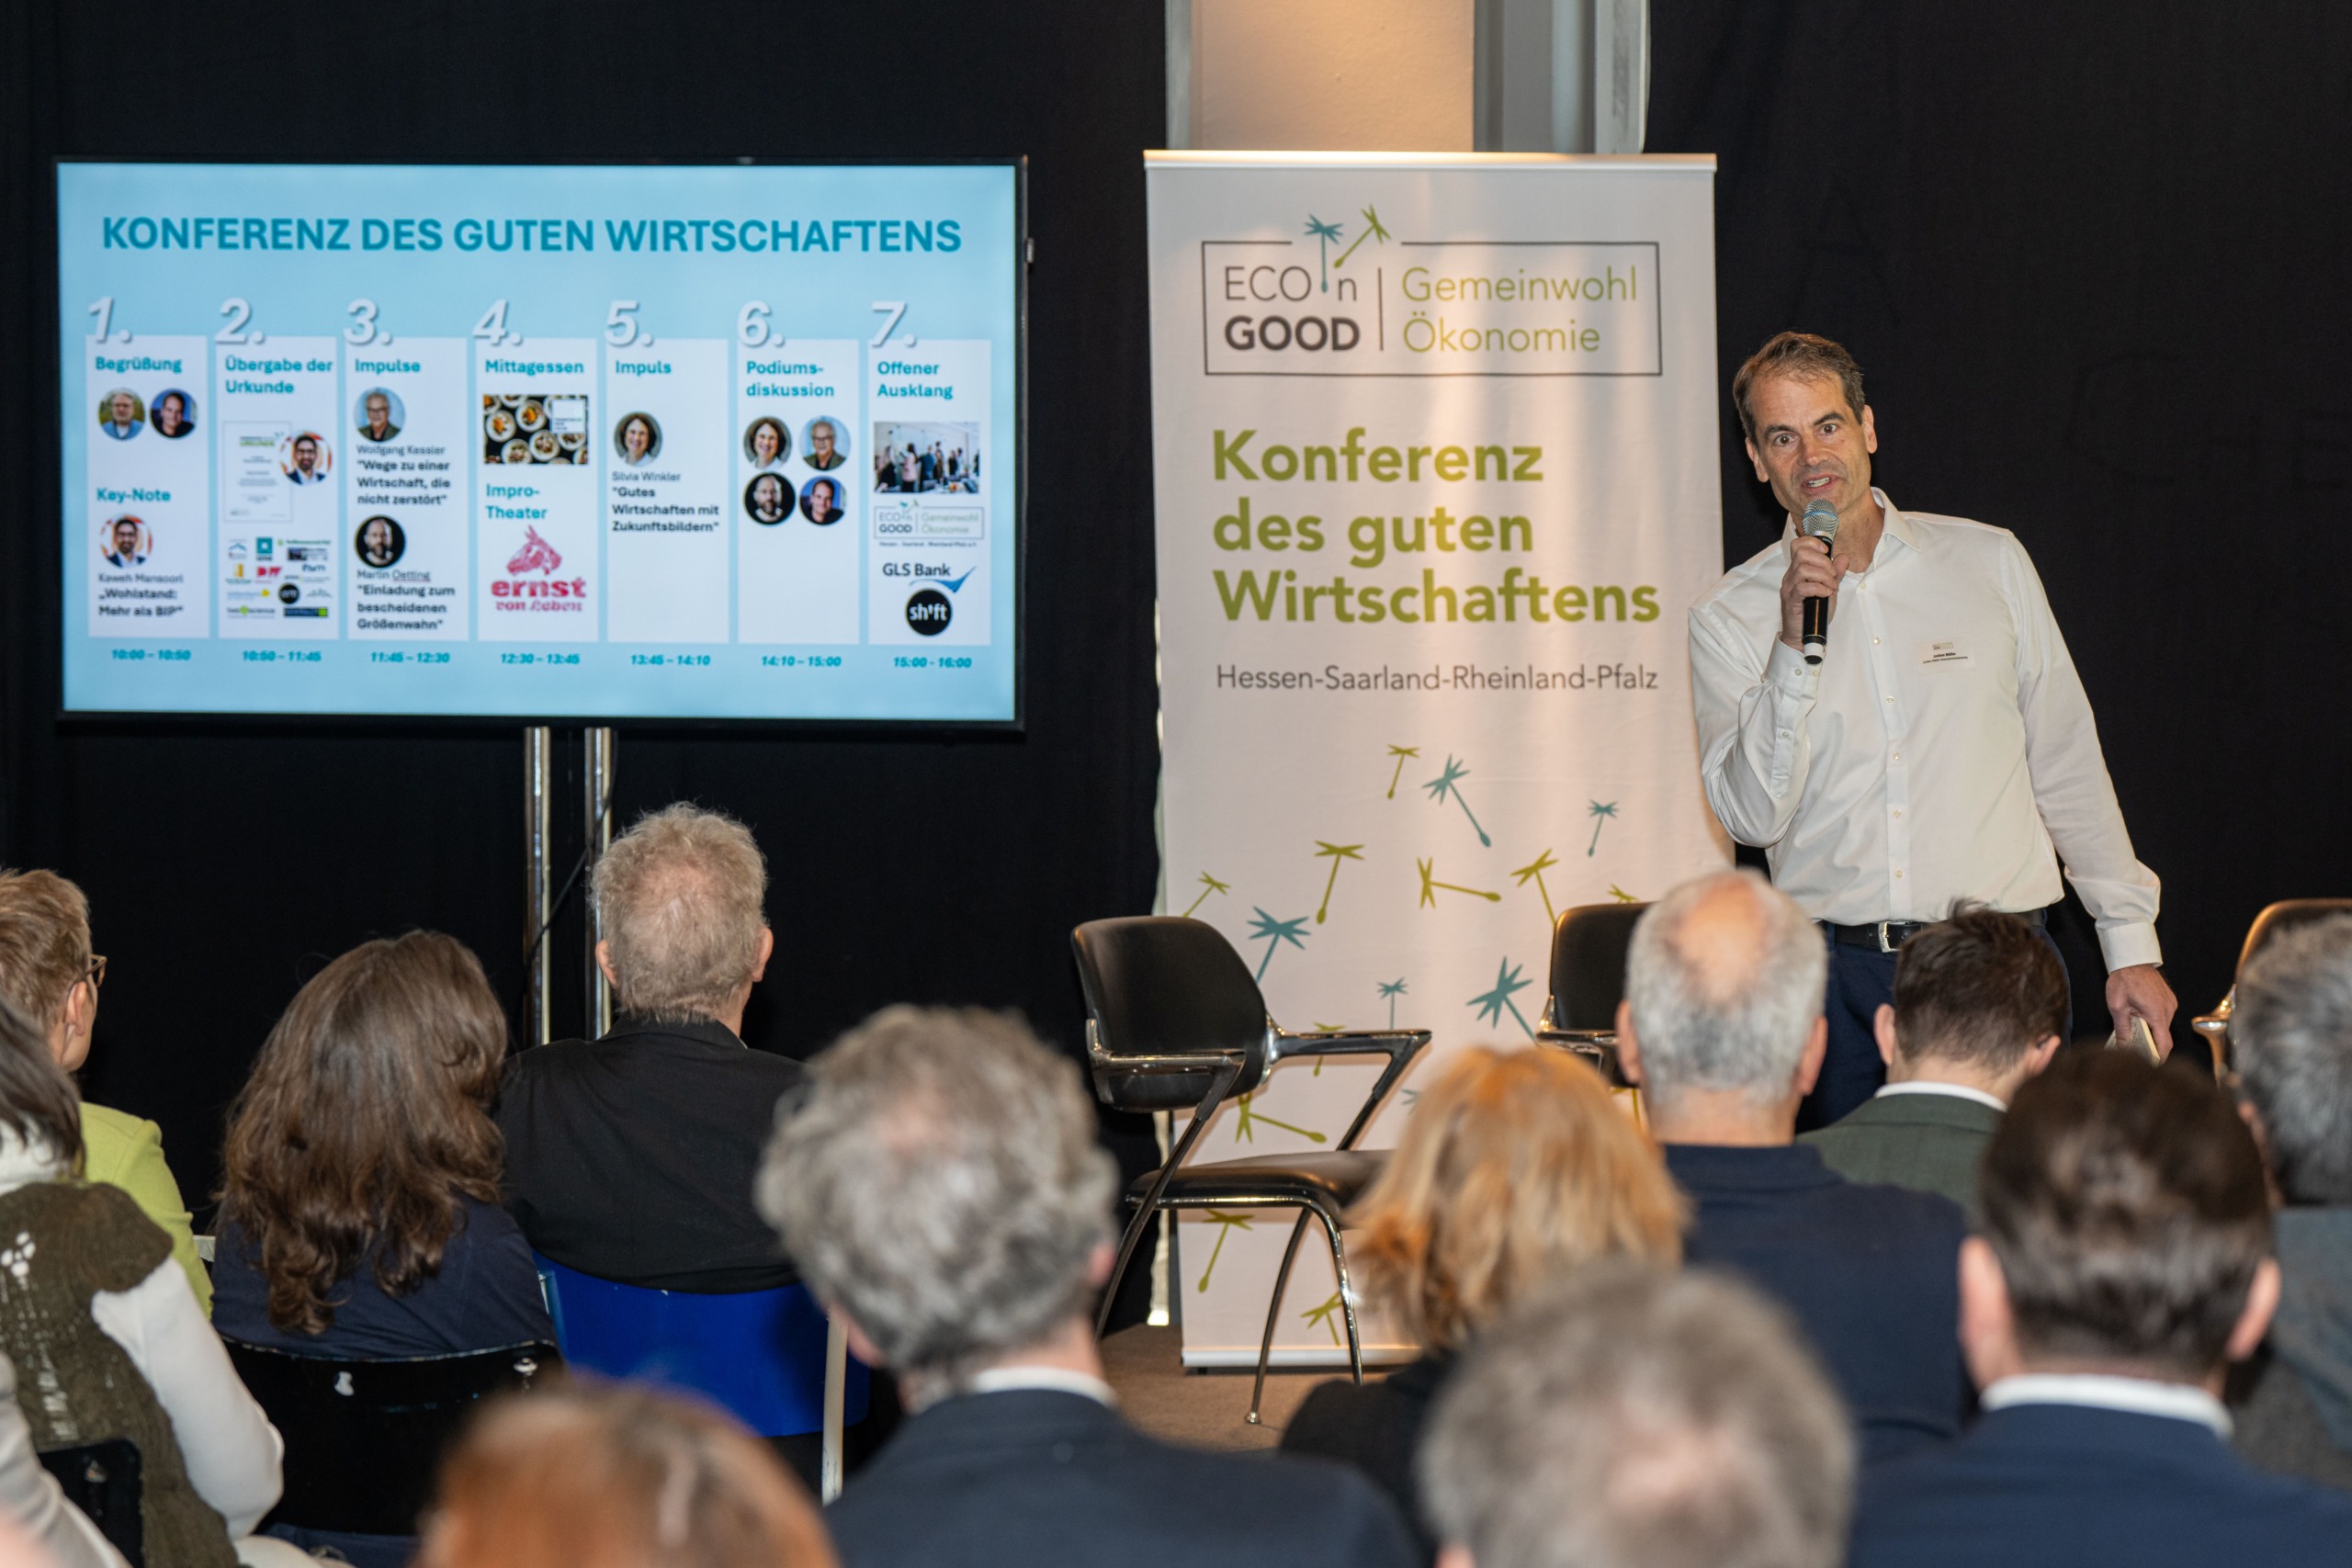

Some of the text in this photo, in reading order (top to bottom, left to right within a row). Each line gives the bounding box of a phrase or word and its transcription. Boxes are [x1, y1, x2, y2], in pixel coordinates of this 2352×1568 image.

[102, 217, 962, 253] KONFERENZ DES GUTEN WIRTSCHAFTENS
[1402, 265, 1637, 303] Gemeinwohl
[86, 297, 133, 344] 1.
[215, 298, 266, 344] 2.
[343, 299, 392, 345] 3.
[471, 299, 523, 346] 4.
[604, 299, 654, 347] 5.
[737, 299, 785, 348] 6.
[870, 300, 918, 348] 7.
[1225, 311, 1600, 353] GOOD Ökonomie
[96, 356, 182, 373] Begrüßung
[225, 355, 333, 374] Übergabe der
[355, 358, 421, 375] Impulse
[485, 359, 584, 376] Mittagessen
[616, 360, 672, 377] Impuls
[746, 360, 824, 375] Podiums-
[877, 361, 940, 375] Offener
[225, 379, 294, 393] Urkunde
[746, 383, 834, 397] diskussion
[877, 383, 953, 400] Ausklang
[356, 445, 445, 456] Wolfgang Kessler
[1213, 427, 1544, 482] Konferenz
[401, 462, 414, 470] zu
[418, 460, 449, 470] einer
[612, 471, 681, 481] Silvia Winkler
[356, 478, 450, 489] Wirtschaft, die
[96, 488, 171, 503] Key-Note
[357, 493, 390, 503] nicht
[486, 483, 539, 499] Impro-
[486, 505, 548, 519] Theater
[612, 504, 719, 514] Wirtschaften mit
[879, 524, 912, 533] GOOD
[1213, 497, 1533, 569] des guten
[357, 570, 390, 579] Martin
[883, 563, 951, 576] GLS Bank
[428, 587, 455, 595] zum
[491, 577, 586, 598] ernst
[1213, 567, 1661, 623] Wirtschaftens
[98, 605, 130, 616] Mehr
[133, 606, 153, 616] als
[357, 603, 446, 613] bescheidenen
[496, 601, 526, 611] von
[112, 649, 145, 660] 10:00
[158, 649, 191, 660] 10:50
[243, 650, 276, 661] 10:50
[288, 650, 322, 661] 11:45
[371, 651, 404, 662] 11:45
[417, 652, 450, 662] 12:30
[501, 653, 534, 664] 12:30
[548, 654, 580, 664] 13:45
[630, 654, 663, 665] 13:45
[677, 655, 710, 665] 14:10
[762, 656, 795, 666] 14:10
[808, 656, 842, 667] 15:00
[894, 657, 927, 668] 15:00
[939, 658, 972, 668] 16:00
[1217, 663, 1659, 691] Hessen-Saarland-Rheinland-Pfalz
